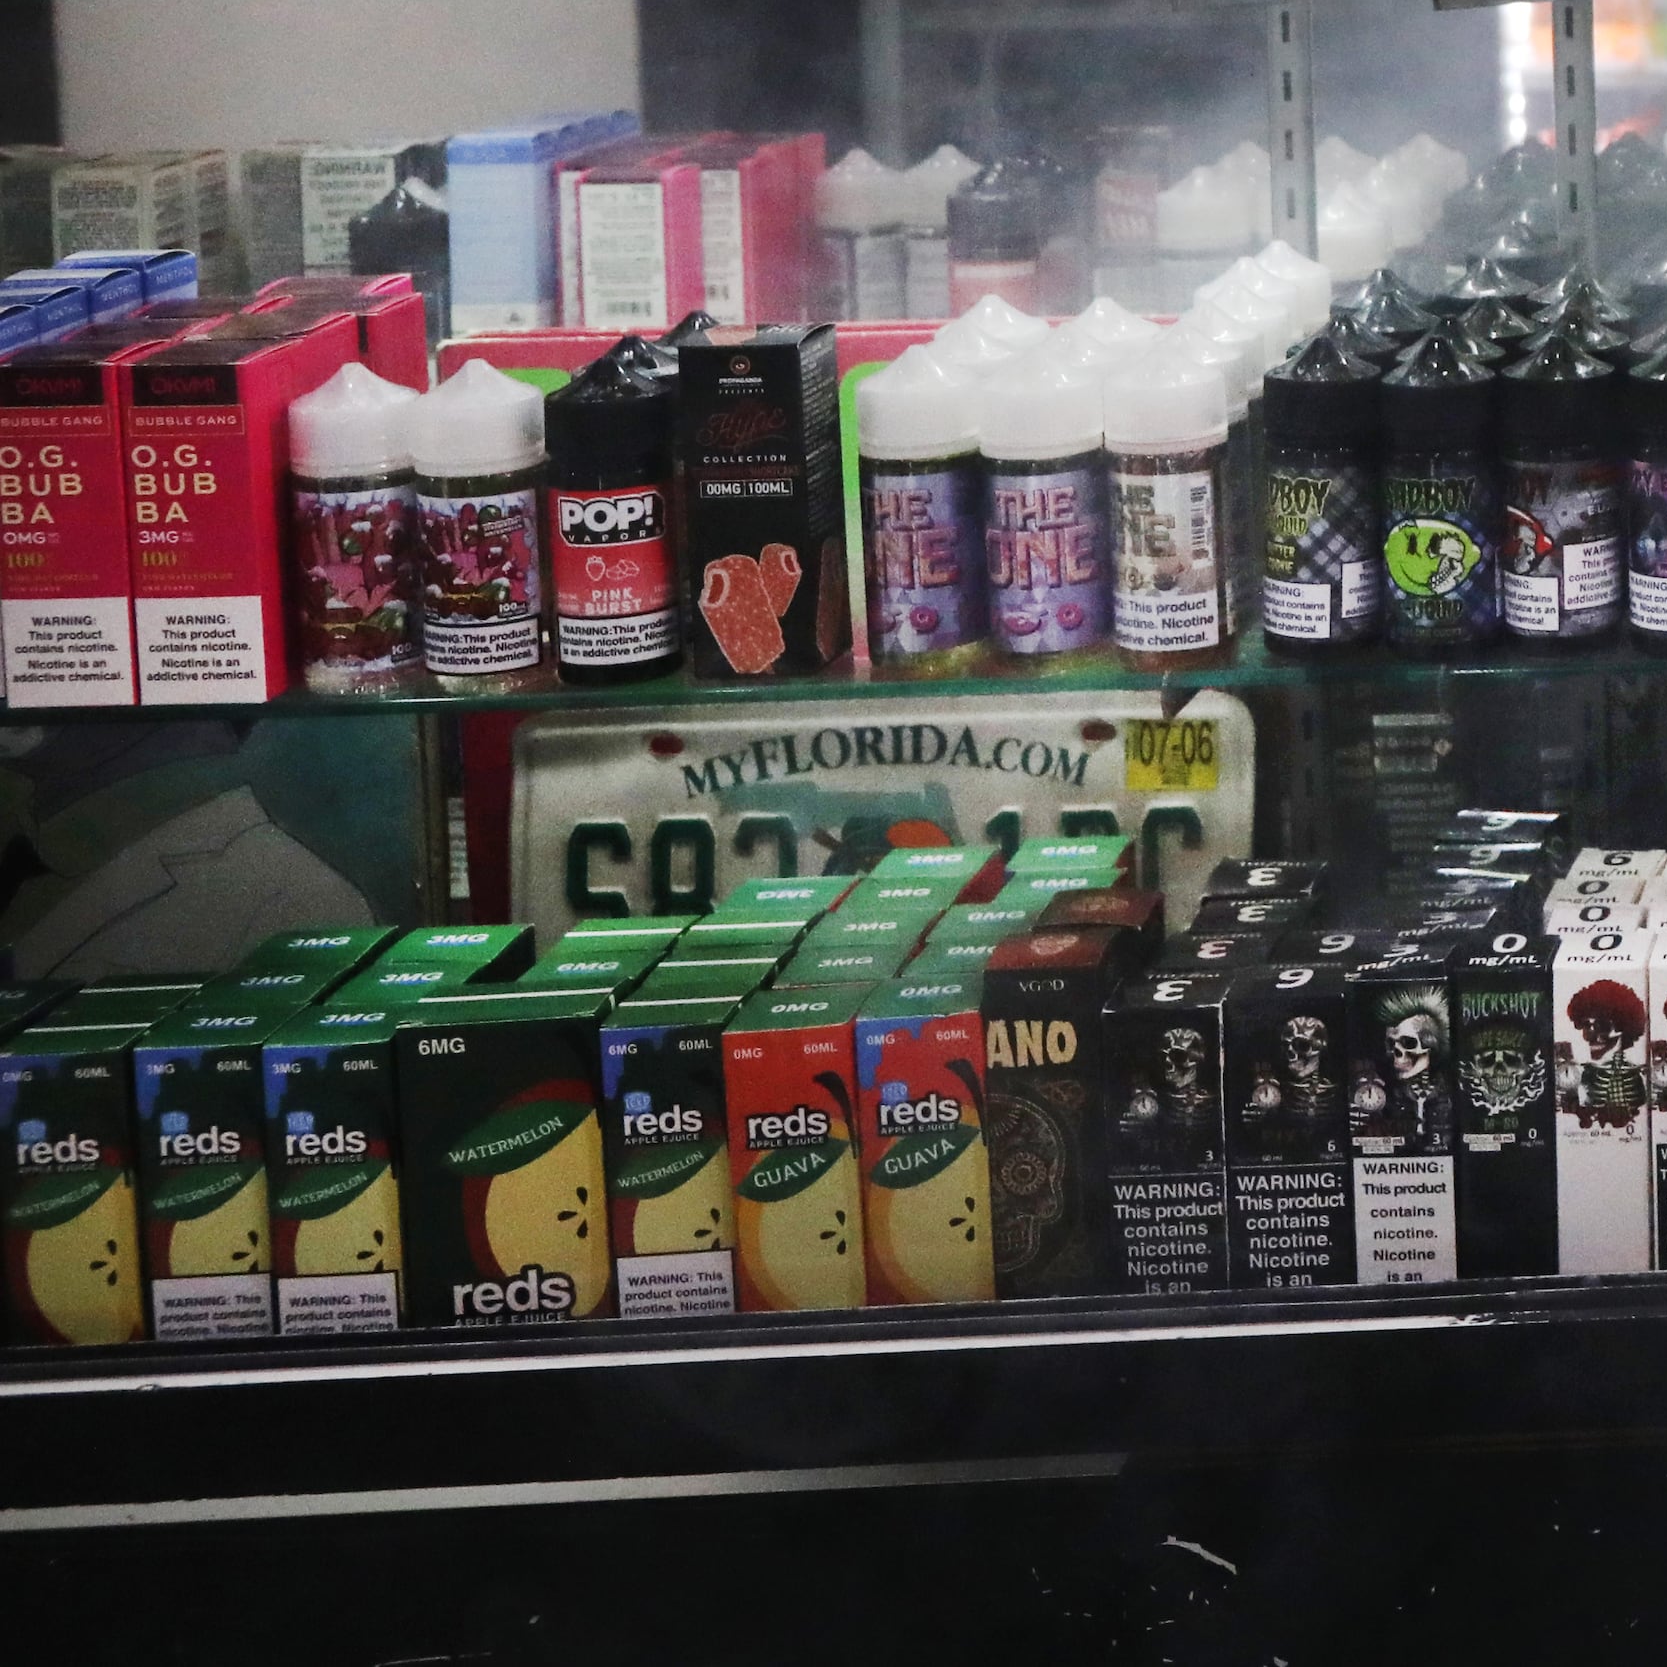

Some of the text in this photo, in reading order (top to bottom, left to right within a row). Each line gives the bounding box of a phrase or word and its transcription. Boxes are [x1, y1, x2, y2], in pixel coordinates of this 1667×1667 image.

[131, 445, 213, 469] O.G.
[704, 455, 787, 463] COLLECTION
[135, 472, 218, 495] BUB
[749, 482, 789, 494] 100ML
[136, 501, 189, 523] BA
[561, 496, 654, 532] POP!
[996, 487, 1075, 527] THE
[138, 530, 180, 544] 3MG
[592, 588, 633, 601] PINK
[585, 600, 642, 615] BURST
[165, 614, 230, 626] WARNING:
[681, 724, 1089, 800] MYFLORIDA.COM
[1462, 991, 1545, 1020] BUCKSHOT
[418, 1037, 466, 1055] 6MG
[733, 1042, 838, 1060] 0MG 60ML
[623, 1108, 702, 1136] reds
[880, 1096, 959, 1125] reds
[747, 1109, 828, 1138] reds
[17, 1135, 99, 1166] reds
[159, 1127, 241, 1157] reds
[285, 1127, 367, 1156] reds
[447, 1116, 564, 1165] WATERMELON
[883, 1138, 956, 1175] GUAVA
[616, 1151, 704, 1188] WATERMELON
[753, 1153, 826, 1189] GUAVA
[1114, 1182, 1221, 1200] WARNING:
[1237, 1173, 1343, 1191] WARNING:
[1113, 1201, 1224, 1220] This product
[1123, 1220, 1208, 1238] contains
[1128, 1239, 1212, 1257] nicotine.
[453, 1276, 573, 1314] reds
